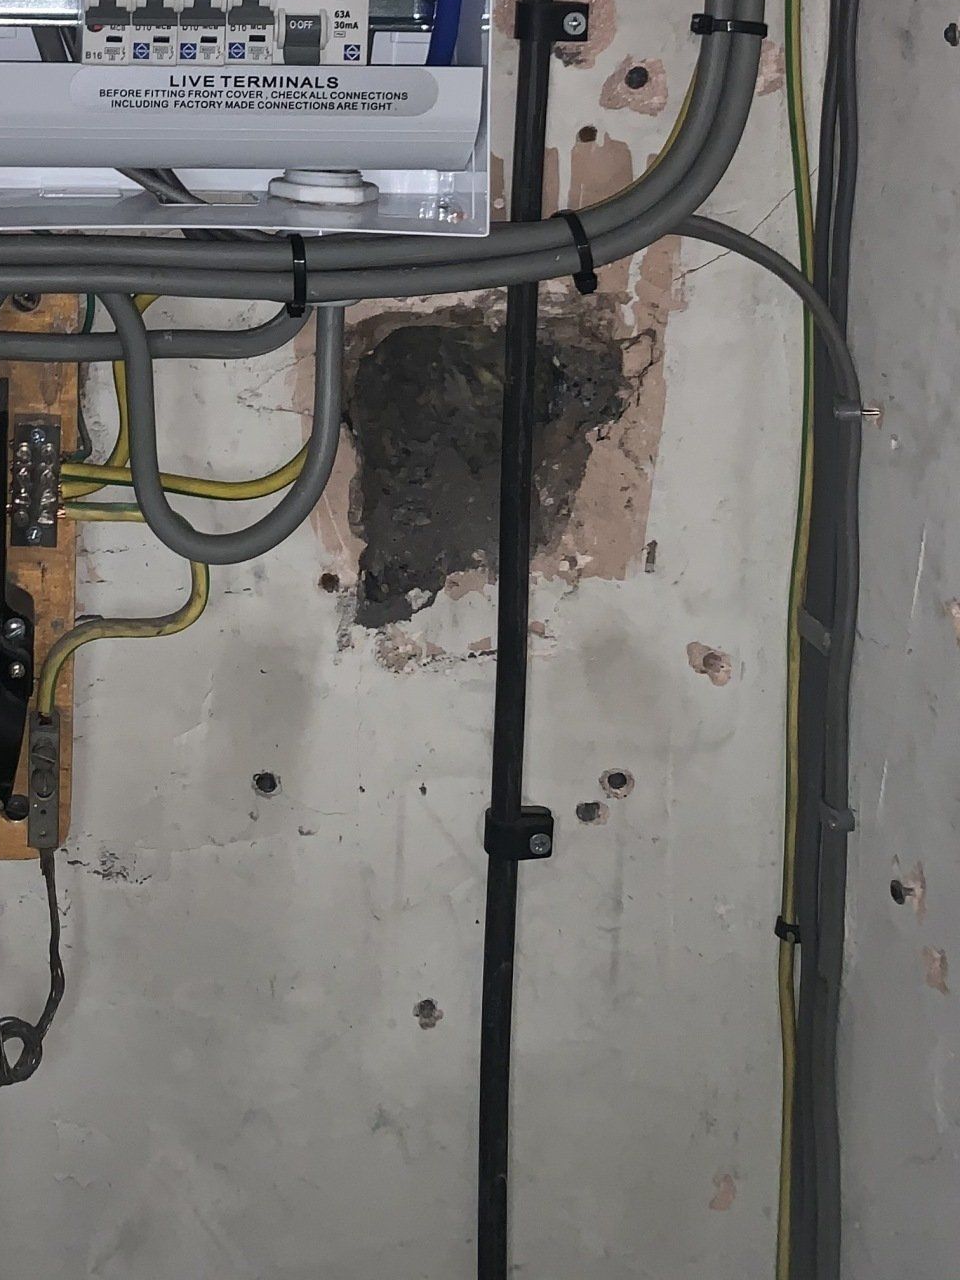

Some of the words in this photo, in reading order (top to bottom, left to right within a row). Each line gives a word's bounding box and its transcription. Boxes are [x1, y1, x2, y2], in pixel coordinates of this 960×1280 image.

[334, 21, 358, 29] 30mA
[170, 75, 215, 87] LIVE
[220, 76, 338, 88] TERMINALS
[100, 89, 141, 97] BEFORE
[144, 89, 185, 98] FITTING
[188, 90, 223, 98] FRONT
[271, 91, 307, 99] CHECK
[309, 91, 328, 99] ALL
[330, 91, 408, 100] CONNECTIONS
[111, 100, 168, 108] INCLUDING
[174, 100, 223, 109] FACTORY
[226, 101, 254, 109] MADE
[258, 102, 335, 110] CONNECTIONS
[337, 102, 358, 110] ARE
